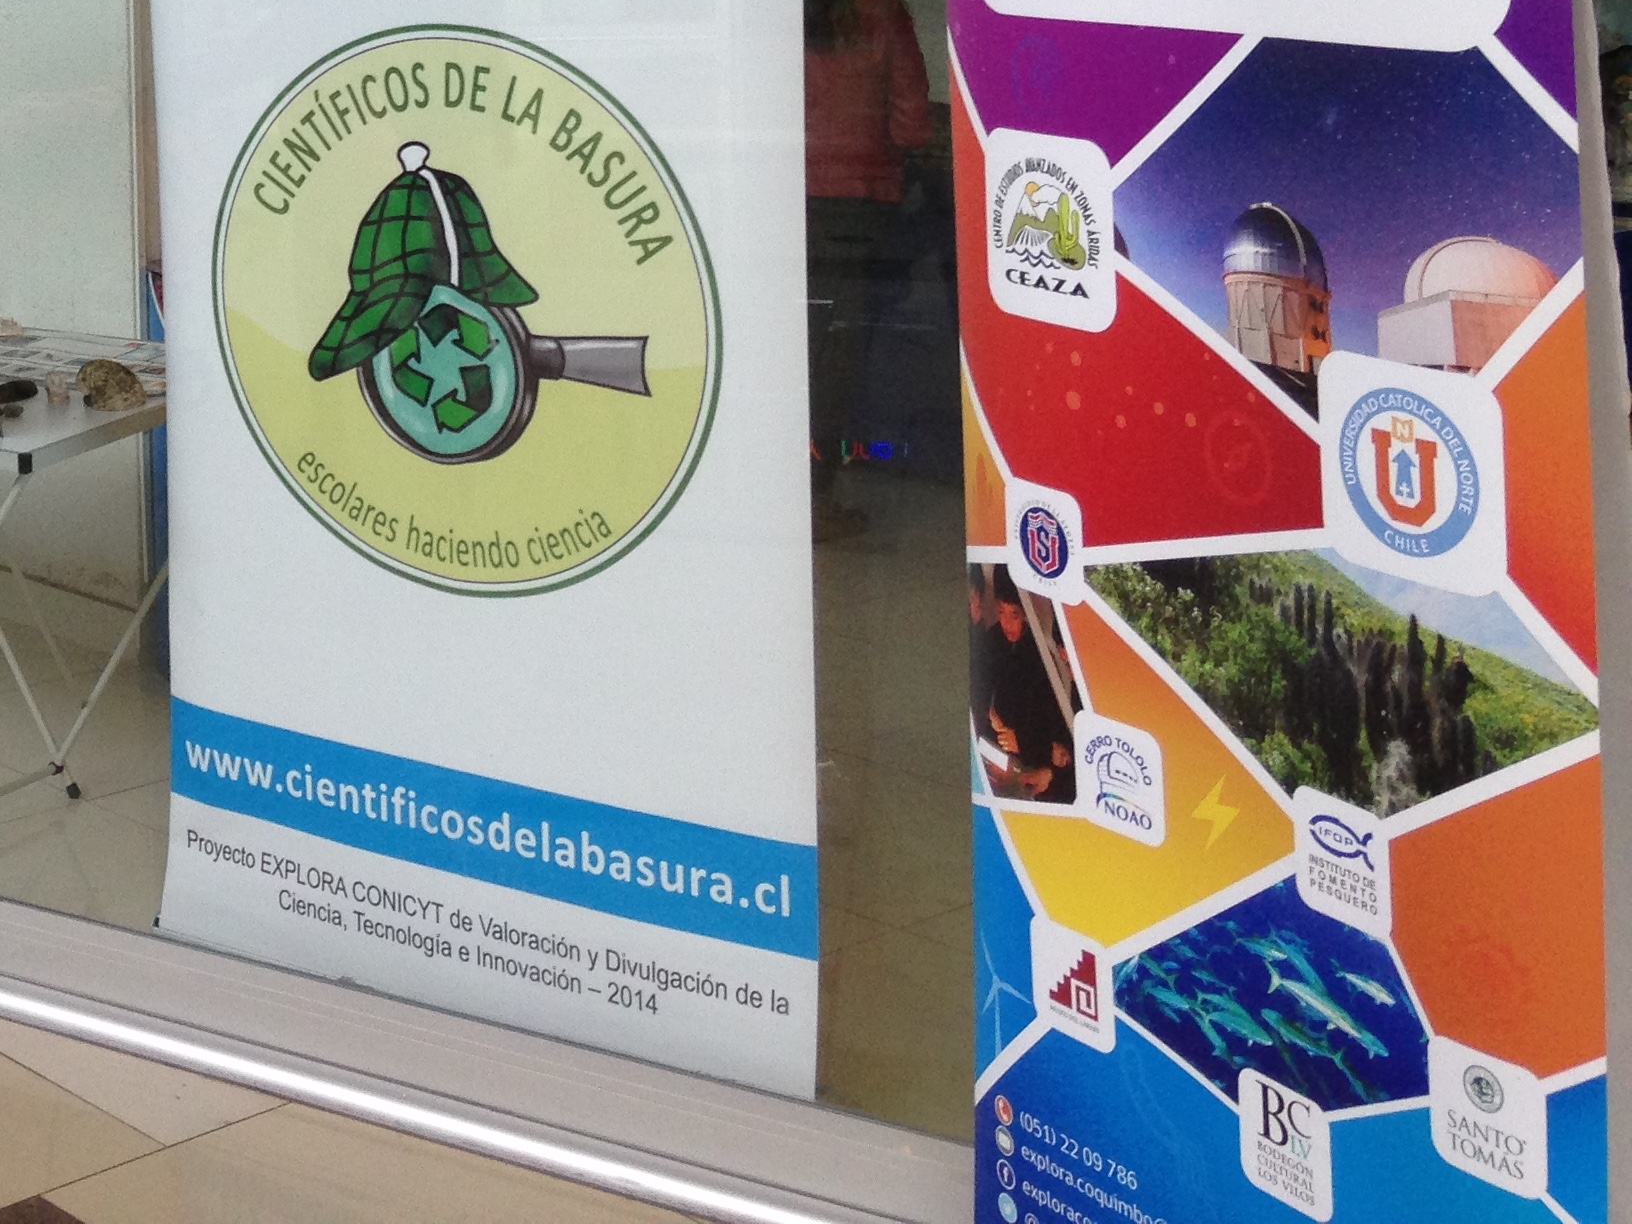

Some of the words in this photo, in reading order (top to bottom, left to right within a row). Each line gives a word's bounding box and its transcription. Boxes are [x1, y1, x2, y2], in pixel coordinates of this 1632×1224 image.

[252, 61, 430, 216] CIENTÍFICOS
[443, 61, 490, 114] DE
[500, 74, 545, 136] LA
[548, 107, 674, 267] BASURA
[992, 209, 1004, 249] CENTRO
[1074, 190, 1096, 226] ZONAS
[1086, 229, 1101, 270] ÁRIDAS
[1005, 268, 1090, 299] CEAZA
[1341, 396, 1379, 485] UNIVERSIDAD
[1378, 392, 1442, 430] CATOLICA
[1440, 426, 1464, 458] DEL
[1458, 459, 1475, 515] NORTE
[295, 448, 400, 544] escolares
[404, 514, 521, 570] haciendo
[525, 505, 613, 568] ciencia
[1383, 529, 1431, 554] CHILE
[1084, 735, 1112, 765] CERRO
[1115, 737, 1152, 786] TOLOLO
[184, 737, 791, 918] www.cientificosdelabasura.cl
[1104, 800, 1153, 830] NOAO
[1309, 854, 1360, 884] INSTITUTO
[1362, 876, 1376, 891] DE
[1309, 865, 1378, 903] FOMENTO
[1309, 877, 1378, 916] PESQUERO
[185, 827, 256, 873] Proyecto
[259, 850, 347, 900] EXPLORA
[351, 878, 444, 925] CONICYT
[449, 906, 473, 932] de
[478, 914, 581, 965] Valoración
[586, 946, 599, 971] y
[605, 949, 729, 1002] Divulgación
[734, 979, 764, 1008] de
[769, 987, 790, 1016] la
[278, 888, 349, 934] Ciencia,
[353, 909, 452, 959] Tecnología
[457, 943, 471, 964] e
[475, 944, 582, 995] Innovación
[606, 983, 659, 1016] 2014
[1254, 1078, 1312, 1147] BC
[1447, 1108, 1525, 1156] SANTO
[1020, 1110, 1056, 1147] (051)
[1059, 1133, 1079, 1160] 22
[1082, 1146, 1104, 1173] 09
[1106, 1158, 1139, 1191] 786
[1446, 1130, 1525, 1180] TOMÁS
